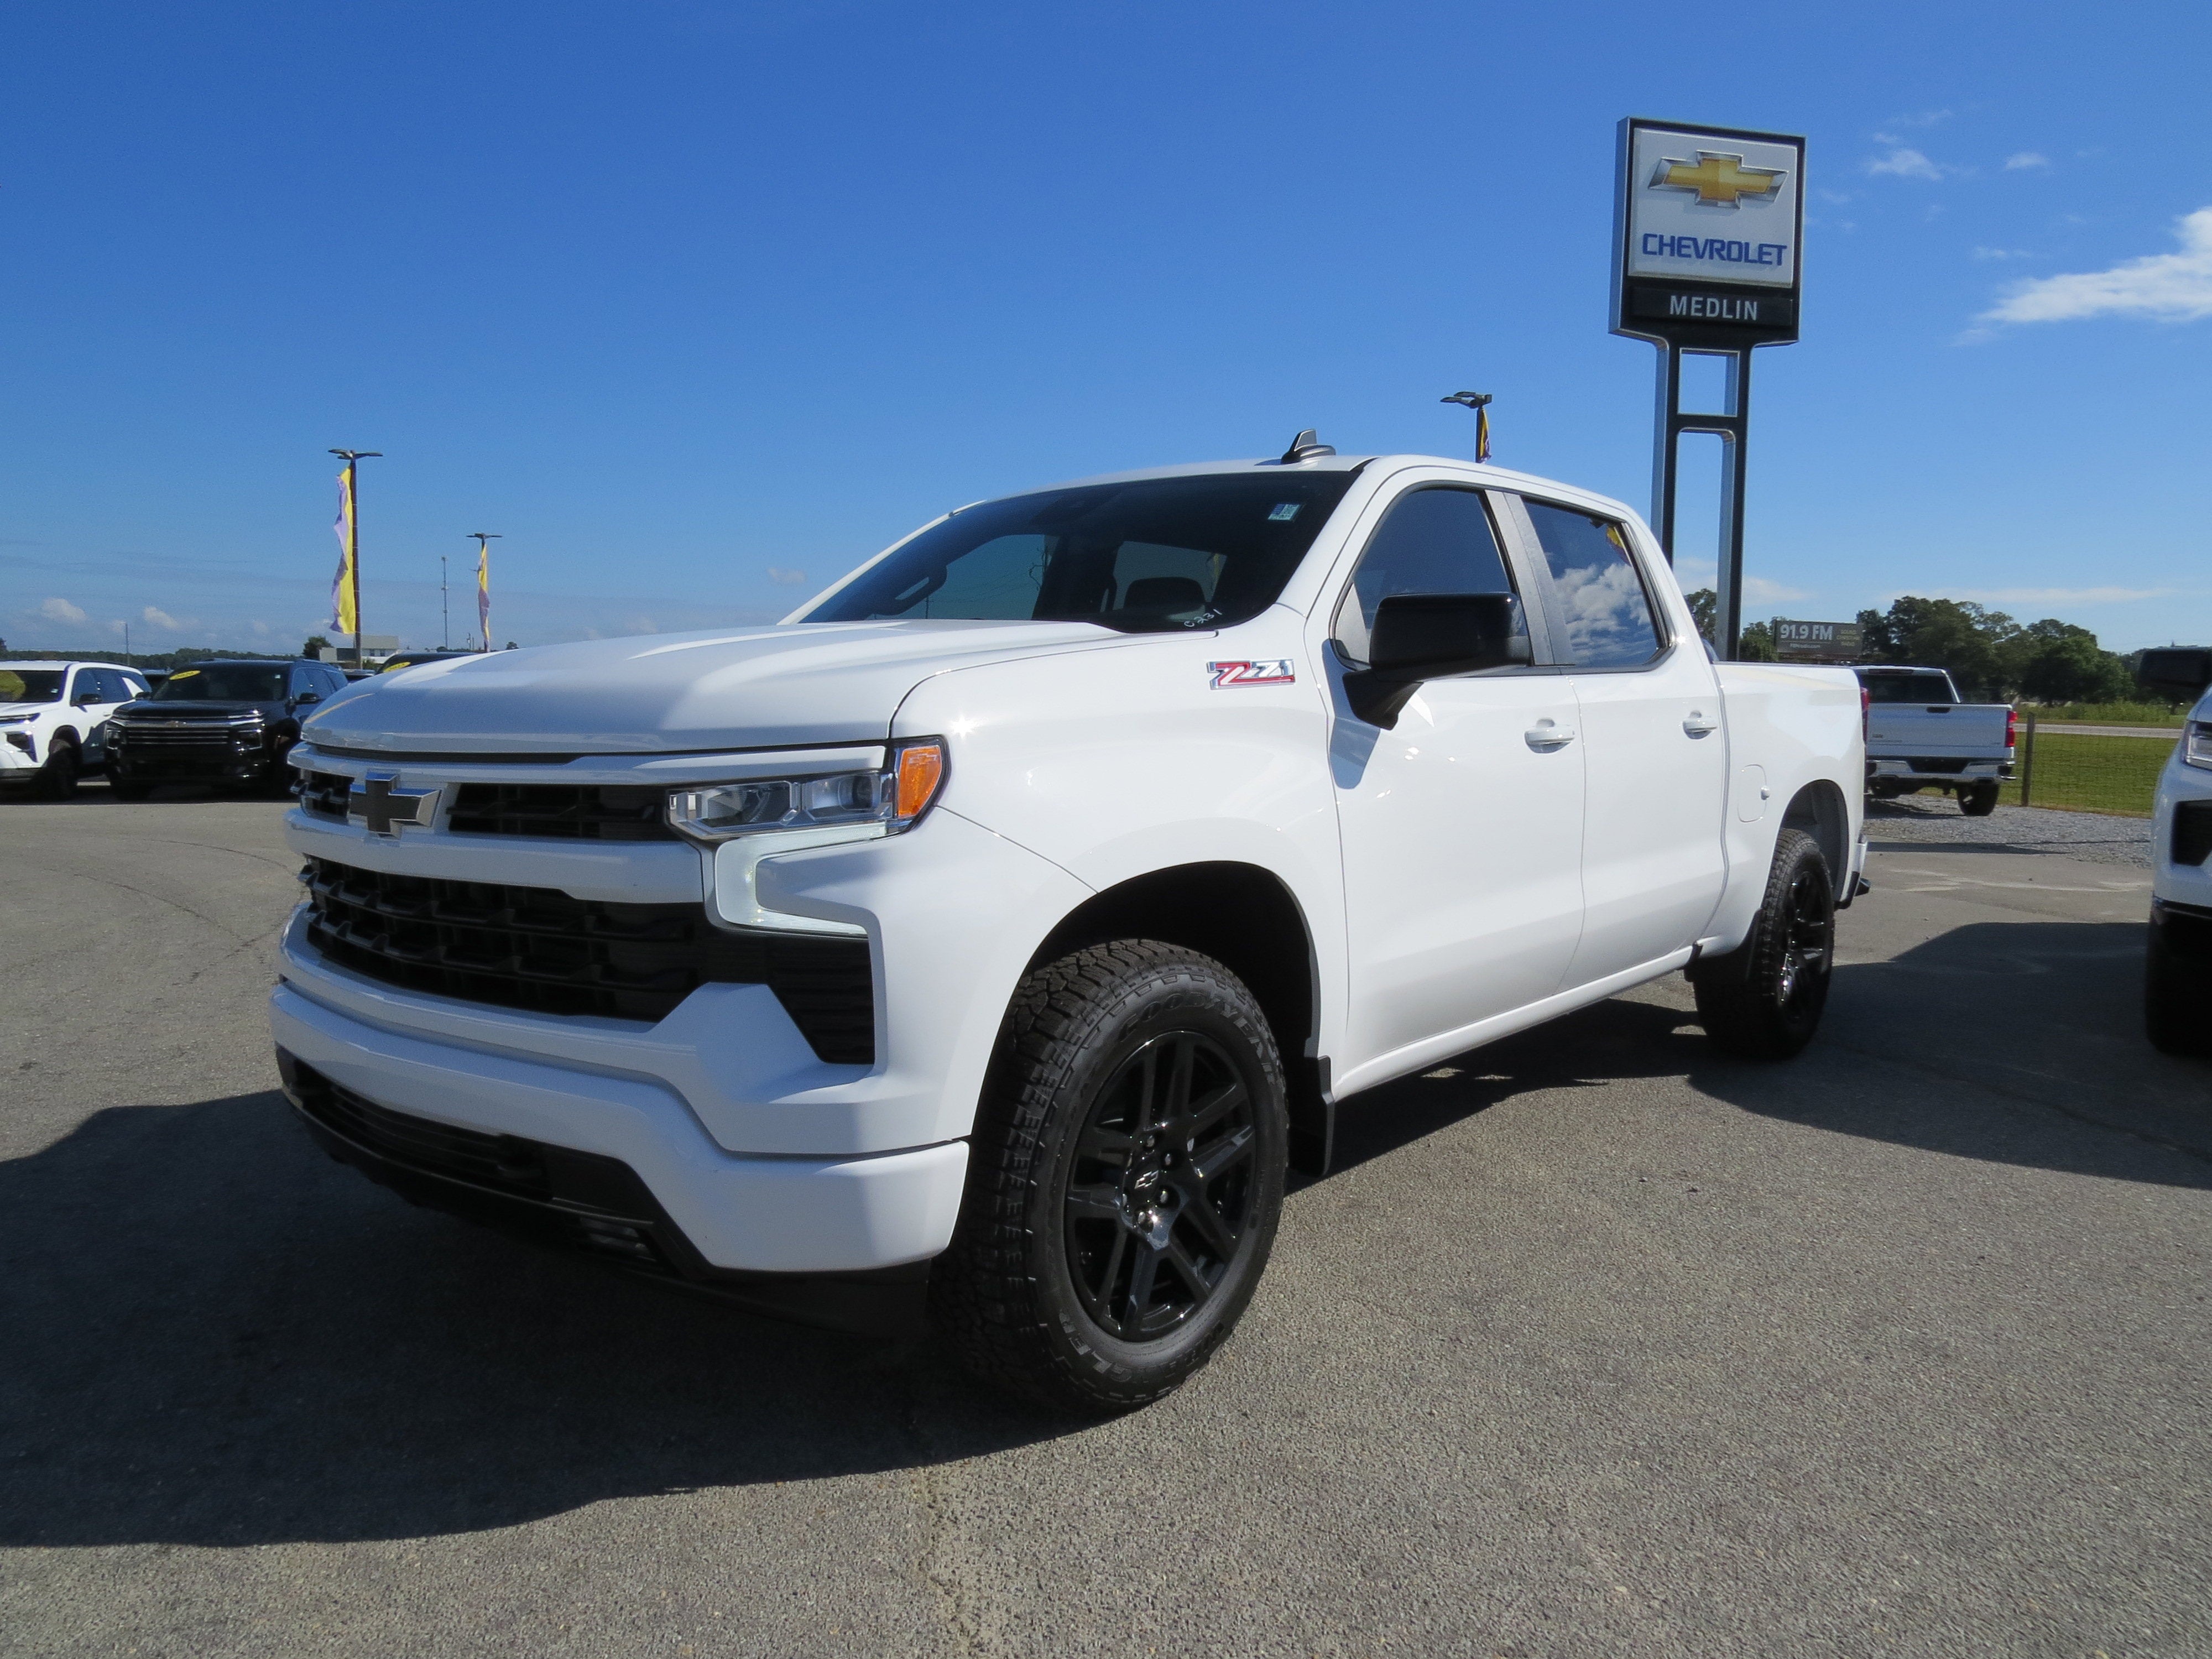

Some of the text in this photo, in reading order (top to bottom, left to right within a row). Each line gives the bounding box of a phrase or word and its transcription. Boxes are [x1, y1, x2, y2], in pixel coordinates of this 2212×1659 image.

[1642, 233, 1787, 266] CHEVROLET
[1669, 295, 1757, 321] MEDLIN
[1780, 624, 1833, 640] 91.9 FM
[1206, 659, 1296, 691] Z71
